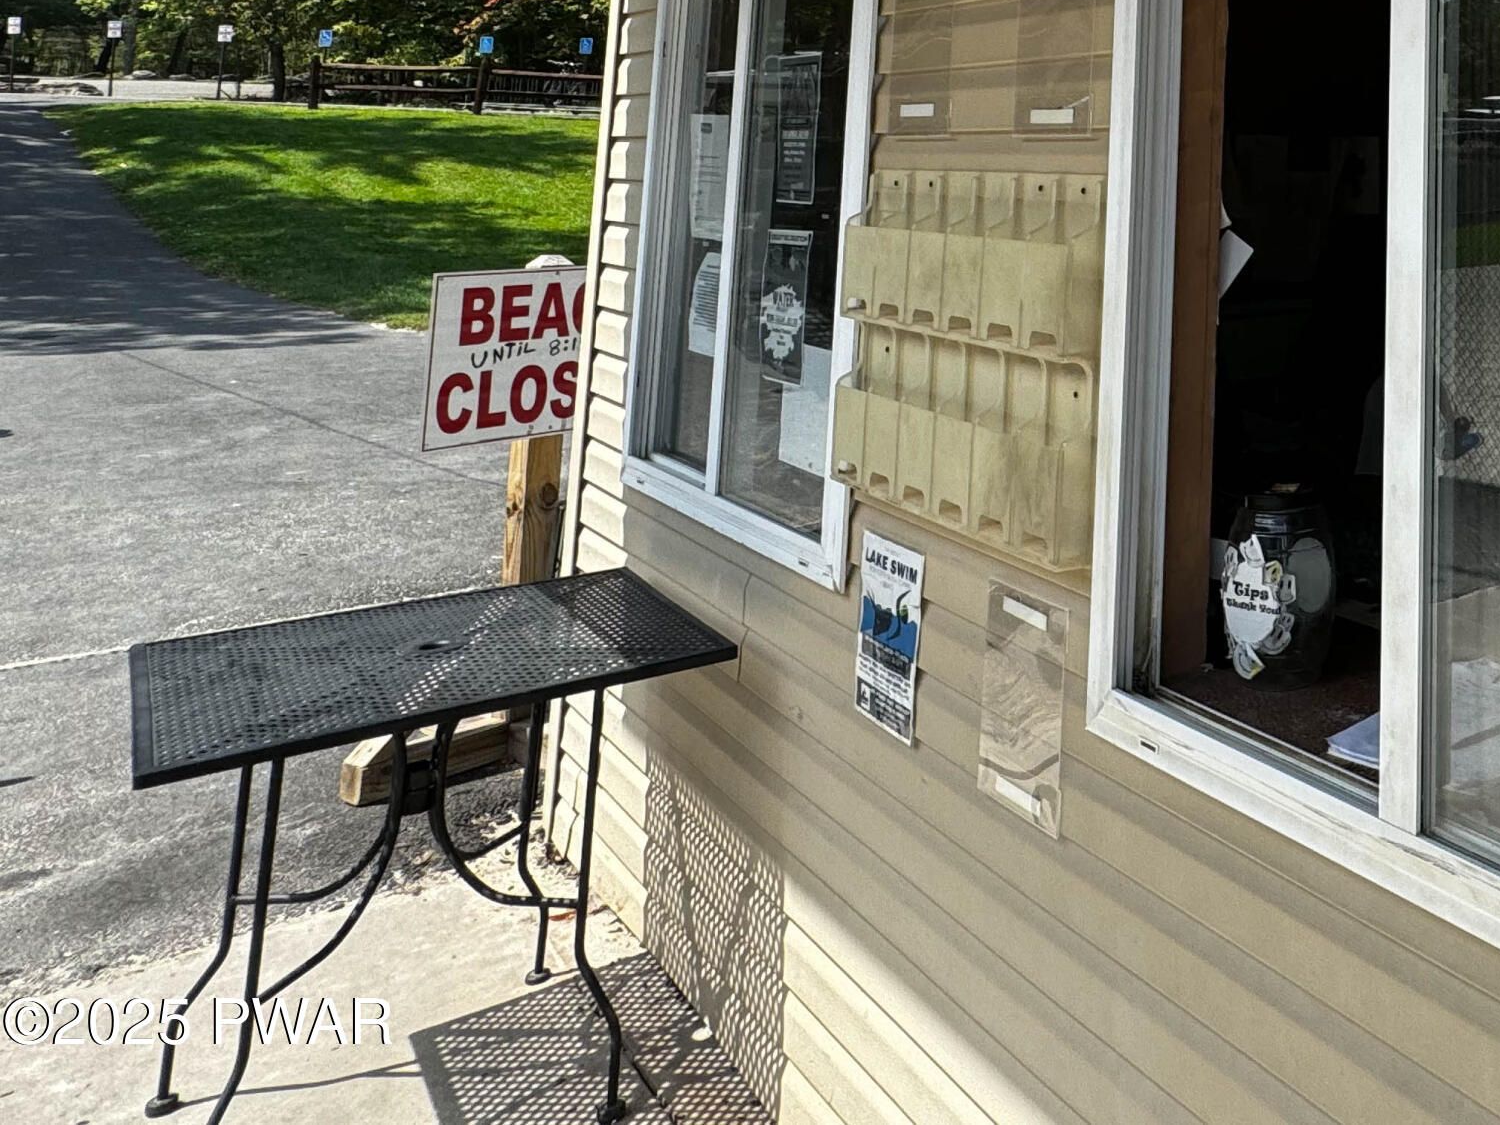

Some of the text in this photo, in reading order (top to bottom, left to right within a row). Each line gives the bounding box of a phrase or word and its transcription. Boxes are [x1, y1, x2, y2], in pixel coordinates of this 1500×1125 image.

[865, 546, 889, 571] LAKE
[890, 559, 918, 585] SWIM
[1232, 580, 1269, 601] Tips
